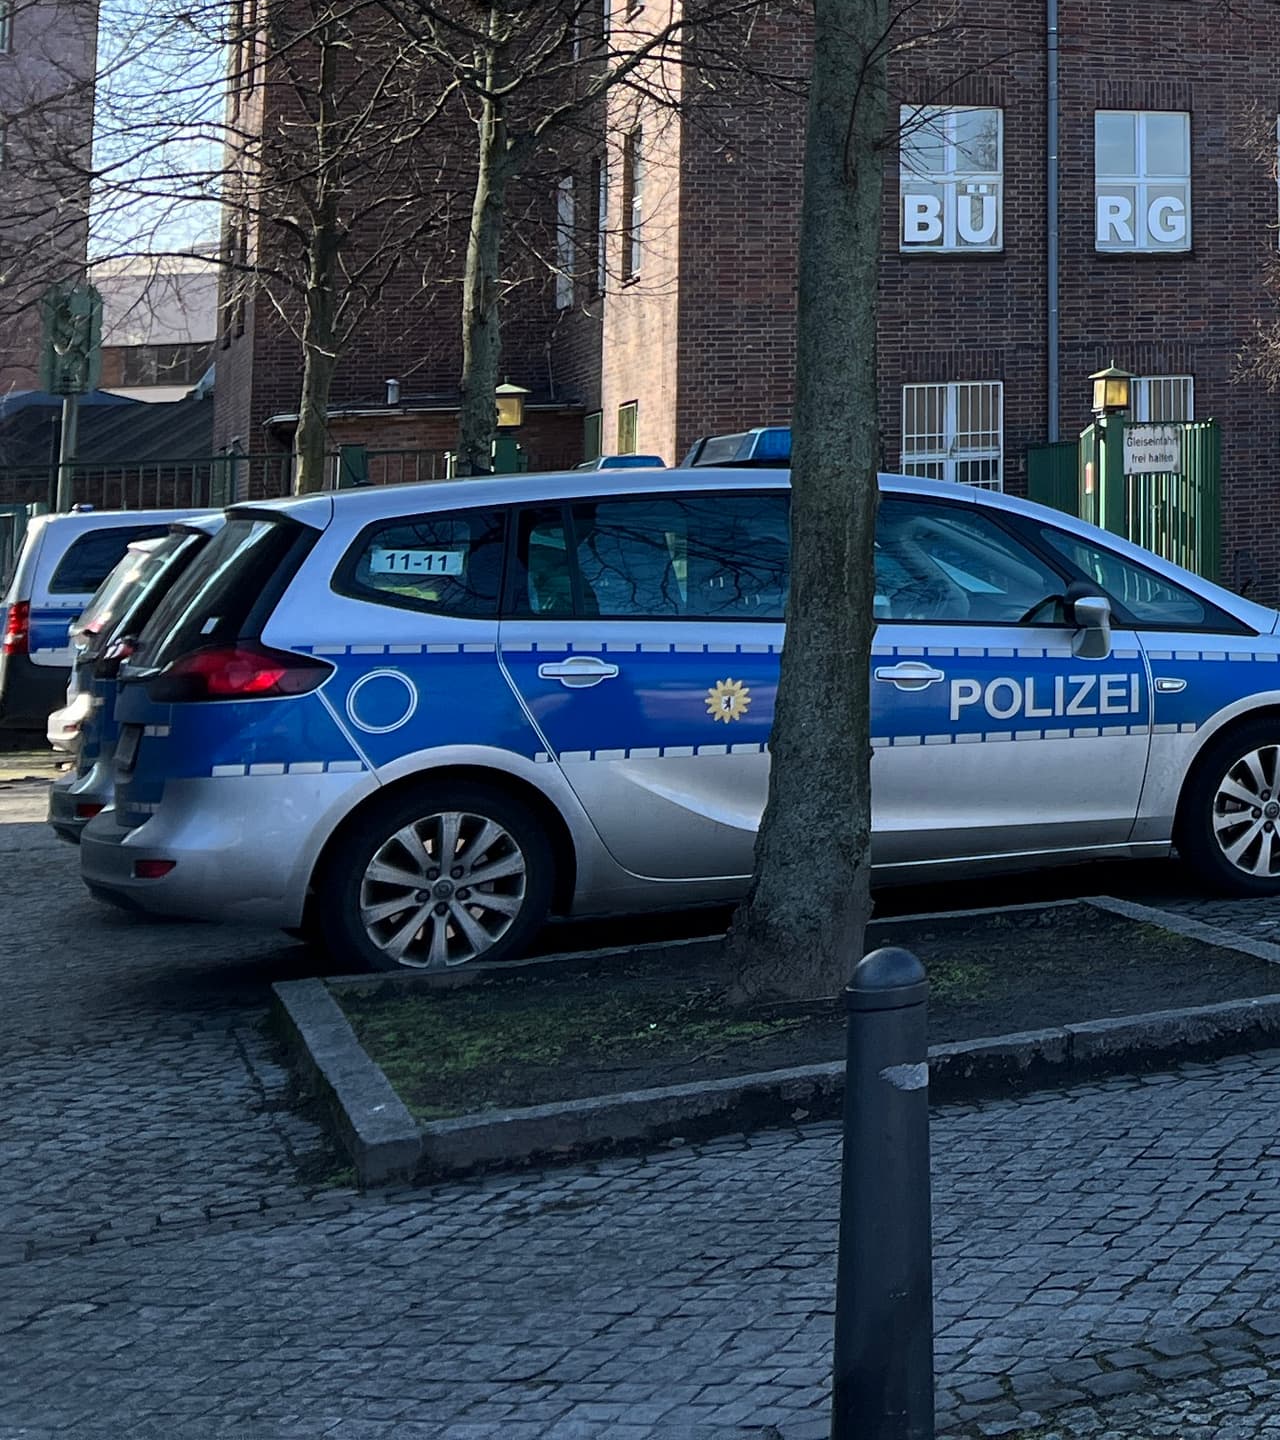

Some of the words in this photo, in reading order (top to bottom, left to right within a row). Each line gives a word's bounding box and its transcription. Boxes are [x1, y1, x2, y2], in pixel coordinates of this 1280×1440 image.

[1132, 453, 1147, 464] frei
[1148, 452, 1174, 464] halten
[385, 553, 448, 572] 11-11
[950, 673, 1139, 721] POLIZEI
